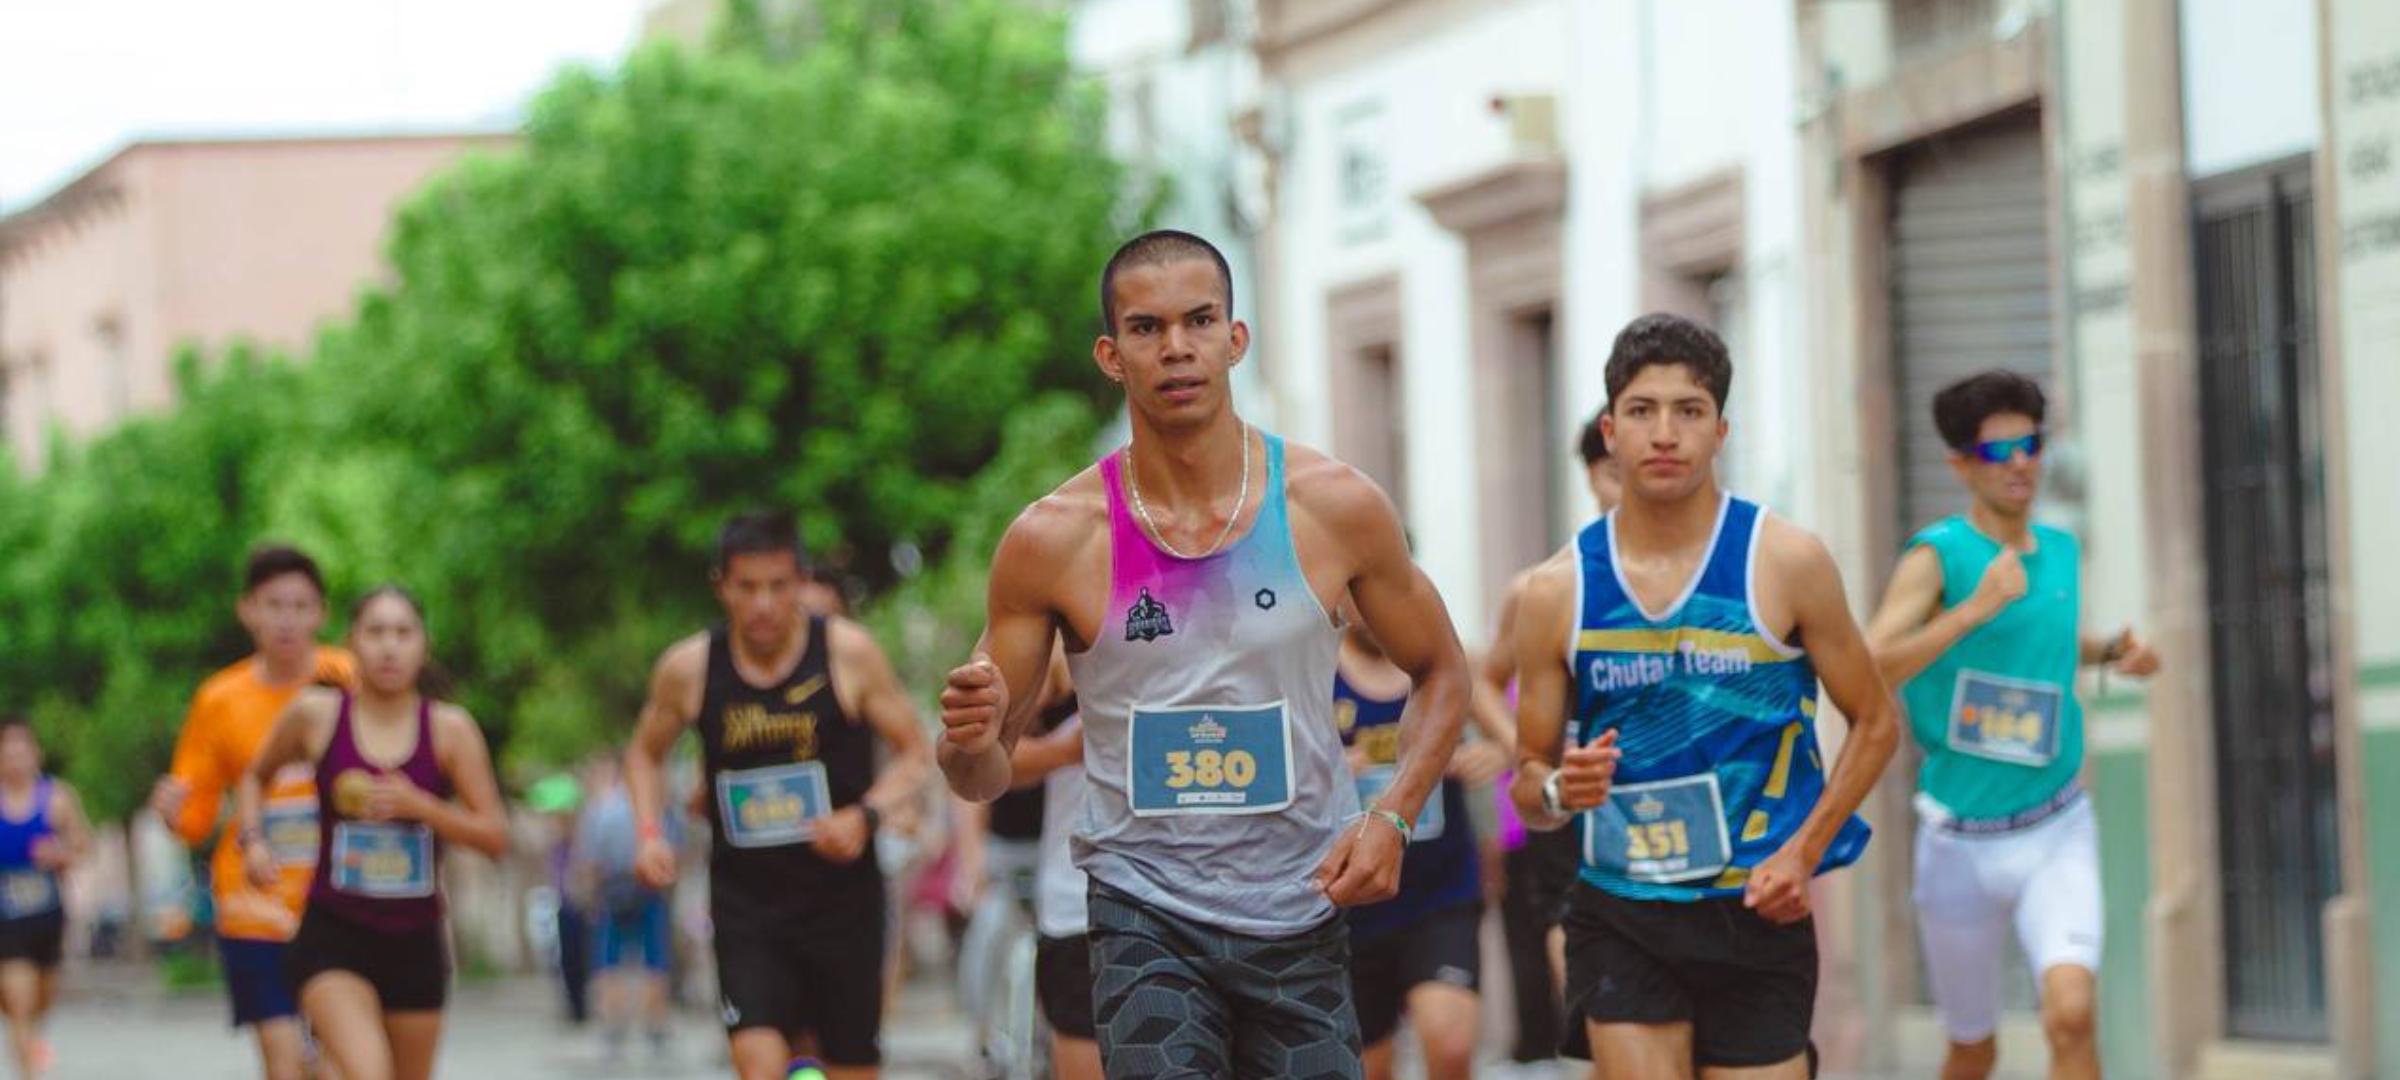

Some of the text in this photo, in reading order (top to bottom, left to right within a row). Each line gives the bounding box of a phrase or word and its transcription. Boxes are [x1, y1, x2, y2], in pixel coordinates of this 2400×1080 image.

[1678, 640, 1753, 675] Team
[1165, 749, 1256, 788] 380
[1626, 820, 1689, 860] 351
